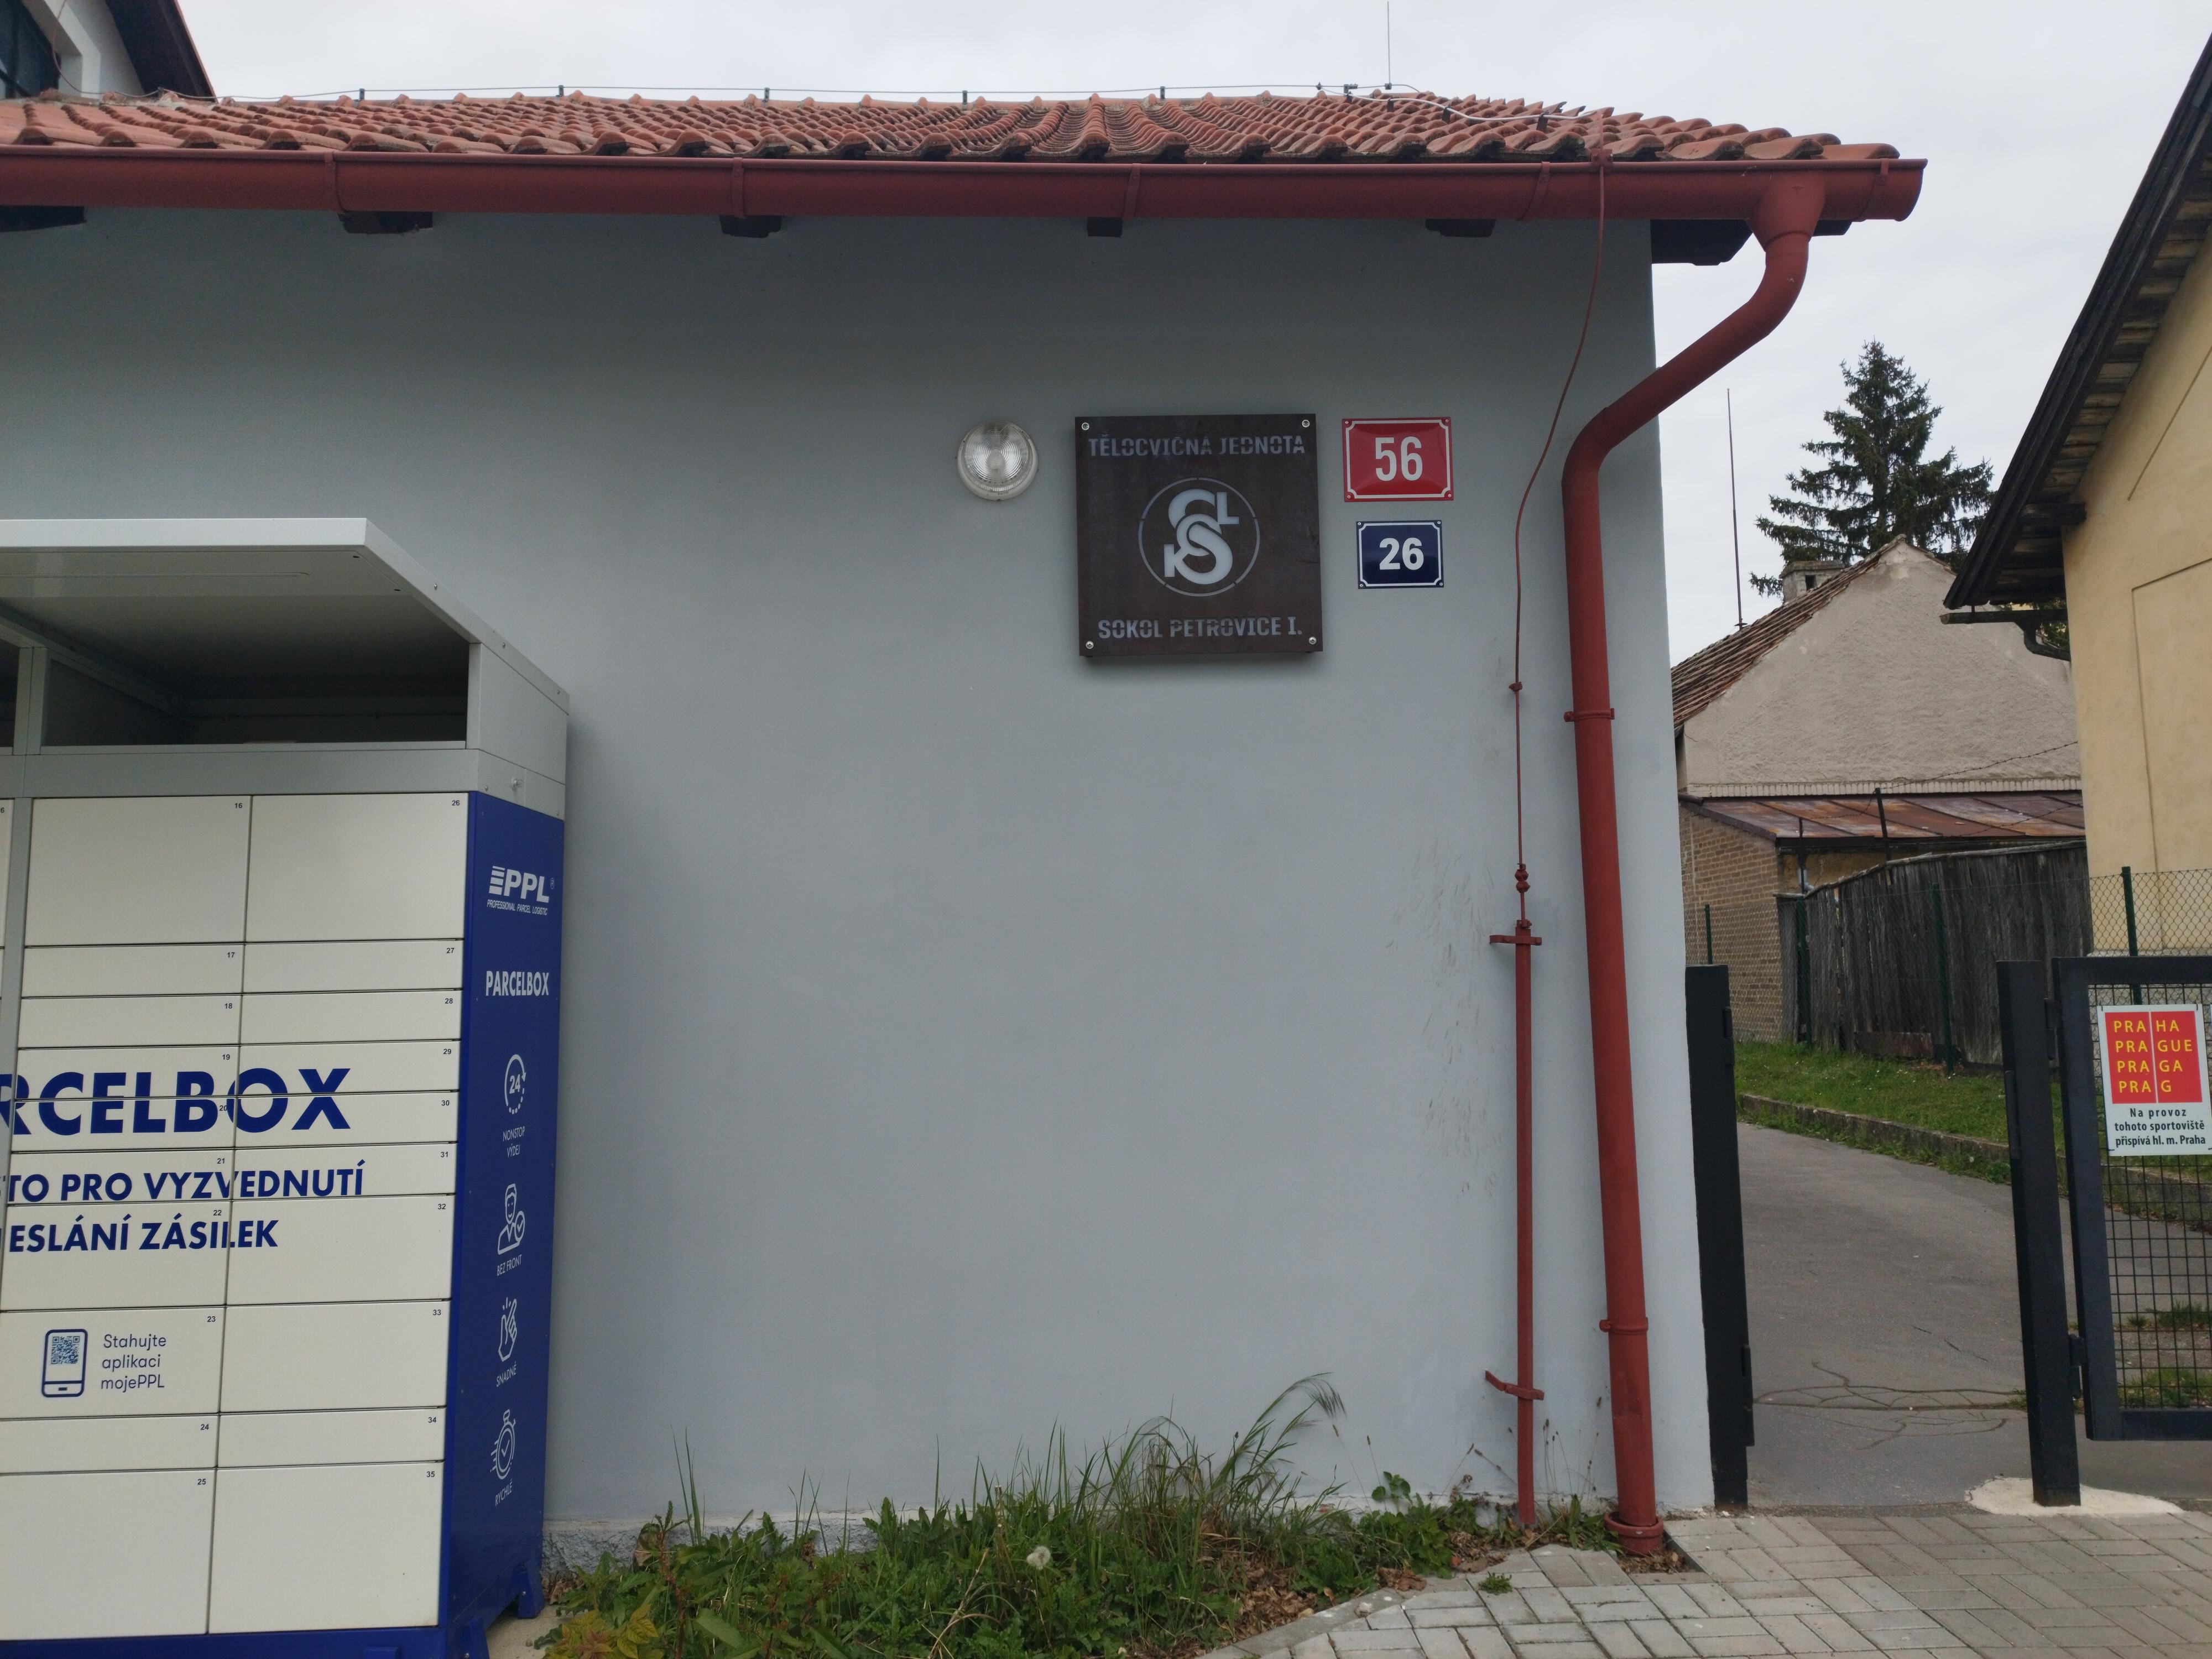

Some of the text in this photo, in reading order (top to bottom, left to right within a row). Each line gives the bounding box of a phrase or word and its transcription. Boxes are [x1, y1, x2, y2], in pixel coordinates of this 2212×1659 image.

[1088, 434, 1305, 456] TĚLOCVIČNÁ JEDNOTA
[1375, 436, 1423, 482] 56
[1379, 537, 1424, 570] 26
[1098, 616, 1302, 639] SOKOL PETROVICE I.
[504, 868, 550, 904] PPL
[487, 899, 549, 916] PROFESSIONAL PARCEL LOGISTIC
[486, 971, 549, 997] PARCELBOX
[509, 1074, 521, 1094] 24
[2130, 1108, 2187, 1119] Na provoz
[503, 1126, 525, 1142] NONSTOP
[2114, 1120, 2205, 1133] tohoto sportoviště
[507, 1143, 520, 1157] VÝDEJ
[2115, 1135, 2151, 1147] přispívá
[2152, 1135, 2164, 1145] hl.
[2180, 1134, 2206, 1145] Praha
[61, 1172, 132, 1201] PRO
[143, 1159, 366, 1199] VYZVEDNUTÍ
[0, 1212, 279, 1253] ESLÁNÍ ZÁSILEK
[497, 1254, 522, 1276] BEZ FRONT
[103, 1333, 166, 1351] Stahujte
[102, 1354, 161, 1372] aplikaci
[496, 1360, 517, 1387] SNADNÉ
[101, 1374, 165, 1393] mojePPL
[495, 1478, 513, 1506] RYCHLÉ
